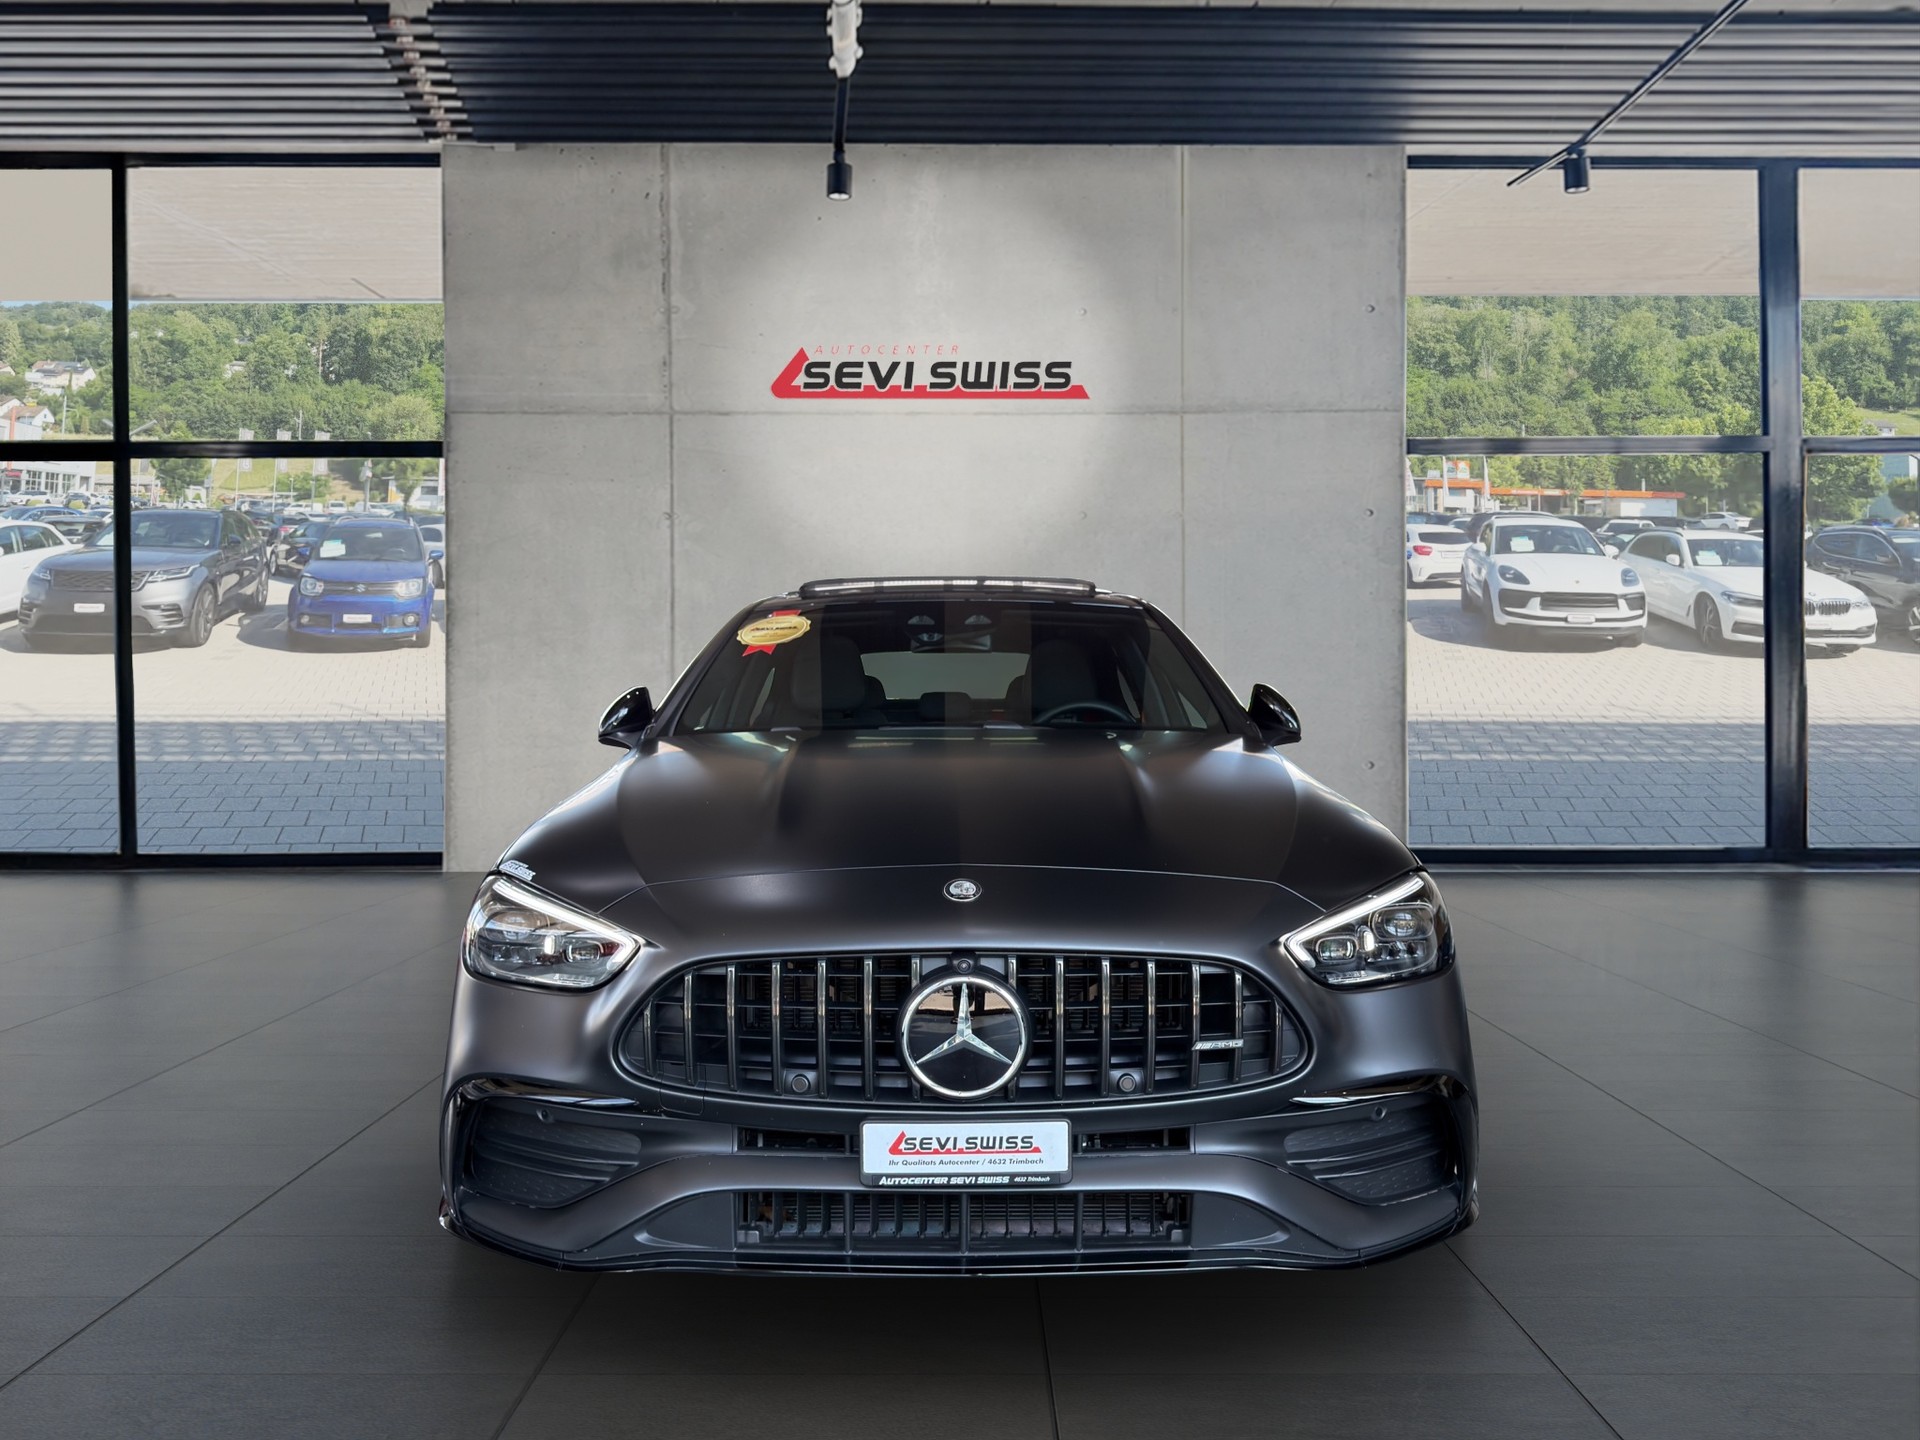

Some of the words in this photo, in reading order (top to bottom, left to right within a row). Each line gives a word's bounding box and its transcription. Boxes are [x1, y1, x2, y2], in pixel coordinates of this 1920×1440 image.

[814, 345, 960, 355] AUTOCENTER
[803, 361, 914, 390] SEVI
[929, 361, 1072, 390] SWISS
[903, 1136, 958, 1151] SEVI
[965, 1135, 1034, 1150] SWISS
[938, 1158, 980, 1166] Autocenter
[987, 1158, 1007, 1166] 4632
[1009, 1157, 1044, 1165] Trimbach
[950, 1176, 975, 1185] SEVI
[977, 1176, 1010, 1184] SWISS
